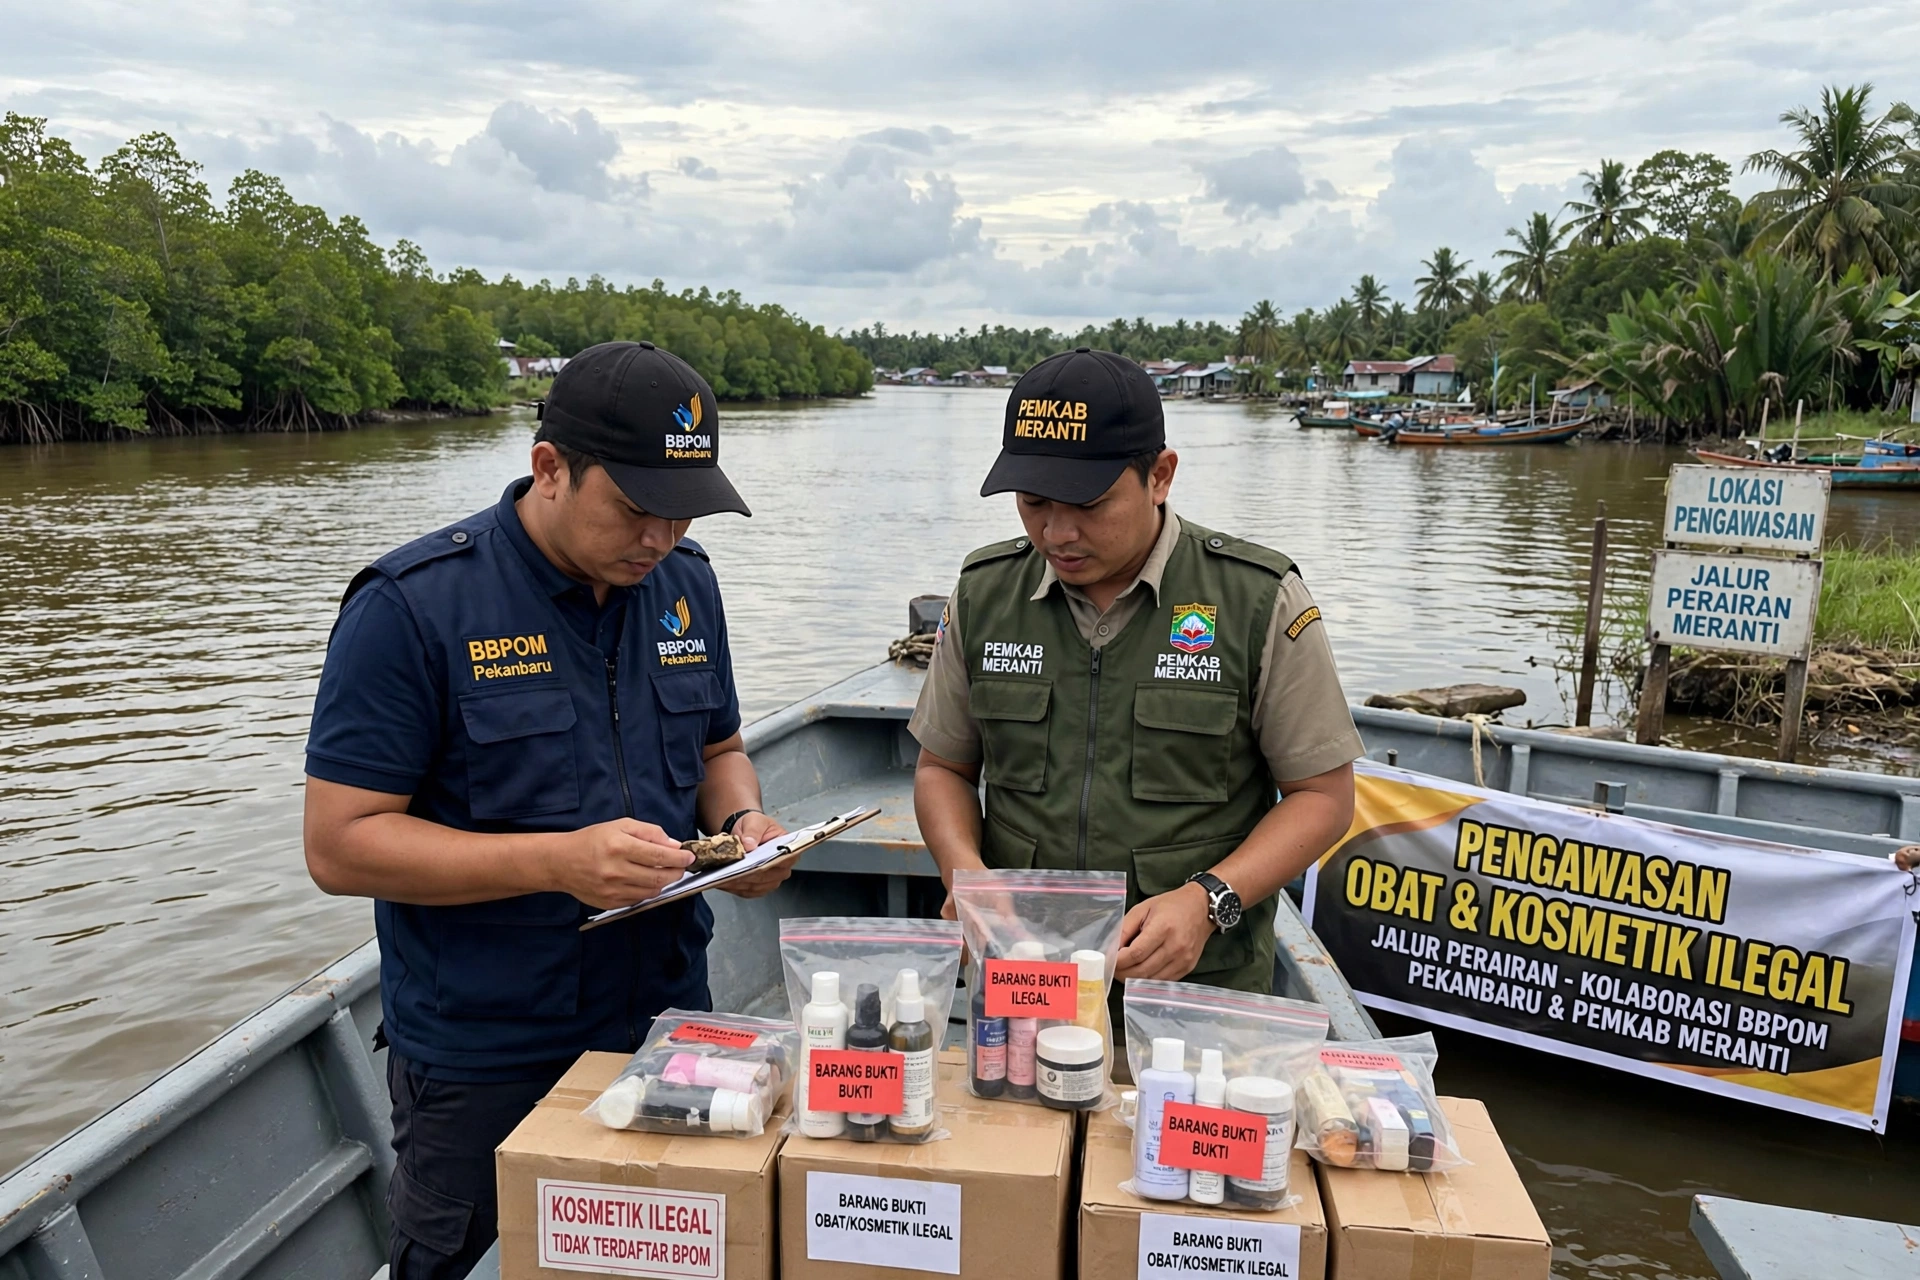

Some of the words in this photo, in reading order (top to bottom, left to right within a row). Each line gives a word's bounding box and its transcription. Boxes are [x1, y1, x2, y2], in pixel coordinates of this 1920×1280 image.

[1018, 399, 1088, 421] PEMKAB
[665, 434, 711, 449] BBPOM
[1014, 420, 1087, 441] MERANTI
[665, 449, 711, 459] Pekanbaru
[1708, 477, 1784, 506] LOKASI
[1673, 505, 1815, 541] PENGAWASAN
[1691, 564, 1770, 591] JALUR
[1667, 587, 1792, 620] PERAIRAN
[1673, 613, 1780, 644] MERANTI
[468, 634, 548, 662] BBPOM
[657, 638, 706, 656] BBPOM
[984, 642, 1044, 659] PEMKAB
[473, 659, 552, 681] Pekanbaru
[660, 653, 707, 666] Pekanbaru
[982, 657, 1042, 675] MERANTI
[1157, 653, 1221, 669] PEMKAB
[1154, 665, 1221, 682] MERANTI
[1456, 820, 1729, 923] PENGAWASAN
[1345, 857, 1445, 923] OBAT
[1449, 881, 1480, 933] &
[1488, 887, 1700, 981] KOSMETIK
[1704, 933, 1852, 1015] ILEGAL
[991, 972, 1036, 987] BARANG
[1038, 974, 1071, 988] BUKTI
[1371, 924, 1441, 962] JALUR
[1445, 940, 1559, 989] PERAIRAN
[1579, 970, 1732, 1029] KOLABORASI
[1737, 1005, 1829, 1051] BBPOM
[1011, 991, 1050, 1006] ILEGAL
[1408, 960, 1542, 1016] PEKANBARU
[1548, 993, 1565, 1021] &
[1571, 998, 1672, 1045] PEMKAB
[1677, 1023, 1790, 1074] MERANTI
[815, 1063, 862, 1079] BARANG
[865, 1065, 898, 1080] BUKTI
[838, 1084, 873, 1099] BUKTI
[1168, 1116, 1219, 1137] BARANG
[1221, 1124, 1258, 1143] BUKTI
[1192, 1140, 1229, 1160] BUKTI
[839, 1193, 888, 1212] BARANG
[891, 1198, 926, 1215] BUKTI
[551, 1195, 644, 1230] KOSMETIK
[649, 1203, 712, 1236] ILEGAL
[814, 1212, 910, 1236] OBAT/KOSMETIK
[912, 1222, 954, 1241] ILEGAL
[552, 1232, 591, 1255] TIDAK
[593, 1236, 669, 1263] TERDAFTAR
[672, 1243, 711, 1267] BPOM
[1172, 1231, 1223, 1250] BARANG
[1226, 1236, 1263, 1254] BUKTI
[1146, 1252, 1245, 1275] OBAT/KOSMETIK
[1248, 1260, 1289, 1278] ILEGAL
